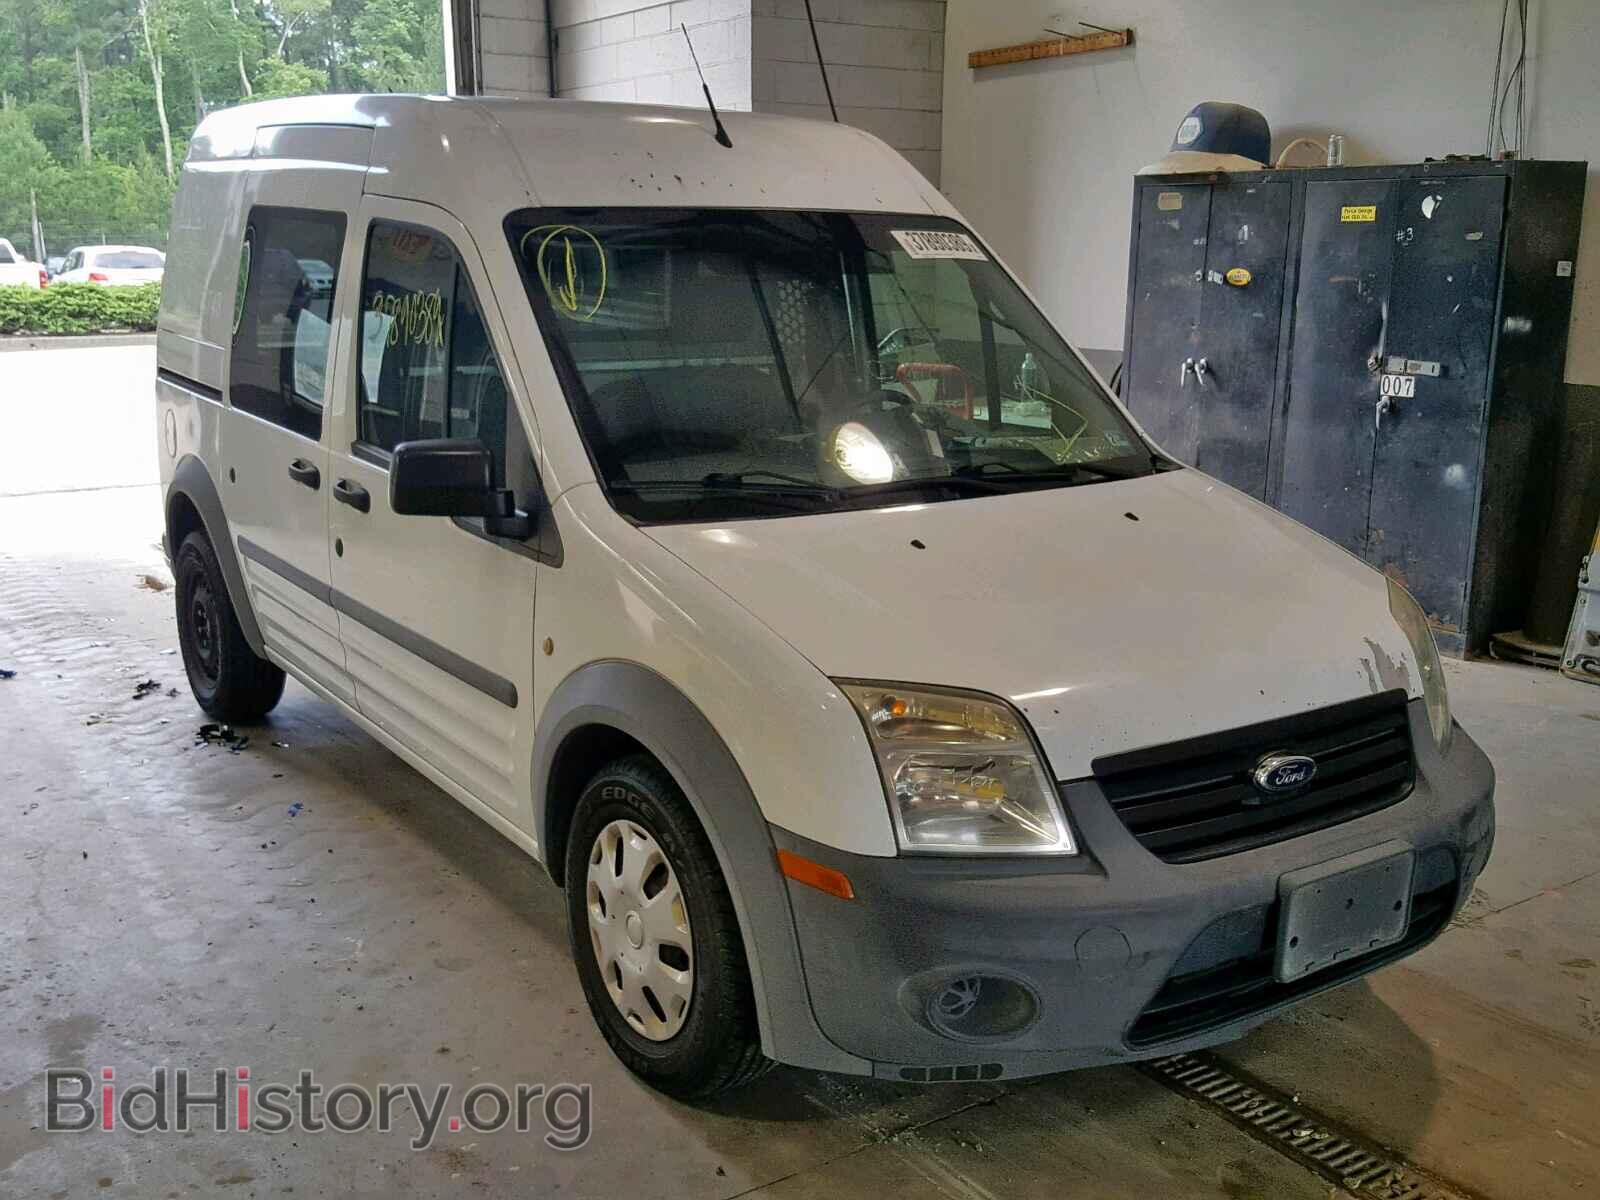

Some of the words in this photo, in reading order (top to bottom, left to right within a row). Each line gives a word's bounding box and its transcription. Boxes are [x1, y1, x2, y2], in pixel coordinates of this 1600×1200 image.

[1395, 227, 1413, 242] #3
[1382, 375, 1412, 396] 007
[1275, 764, 1306, 785] Ford
[601, 786, 656, 819] EDGE
